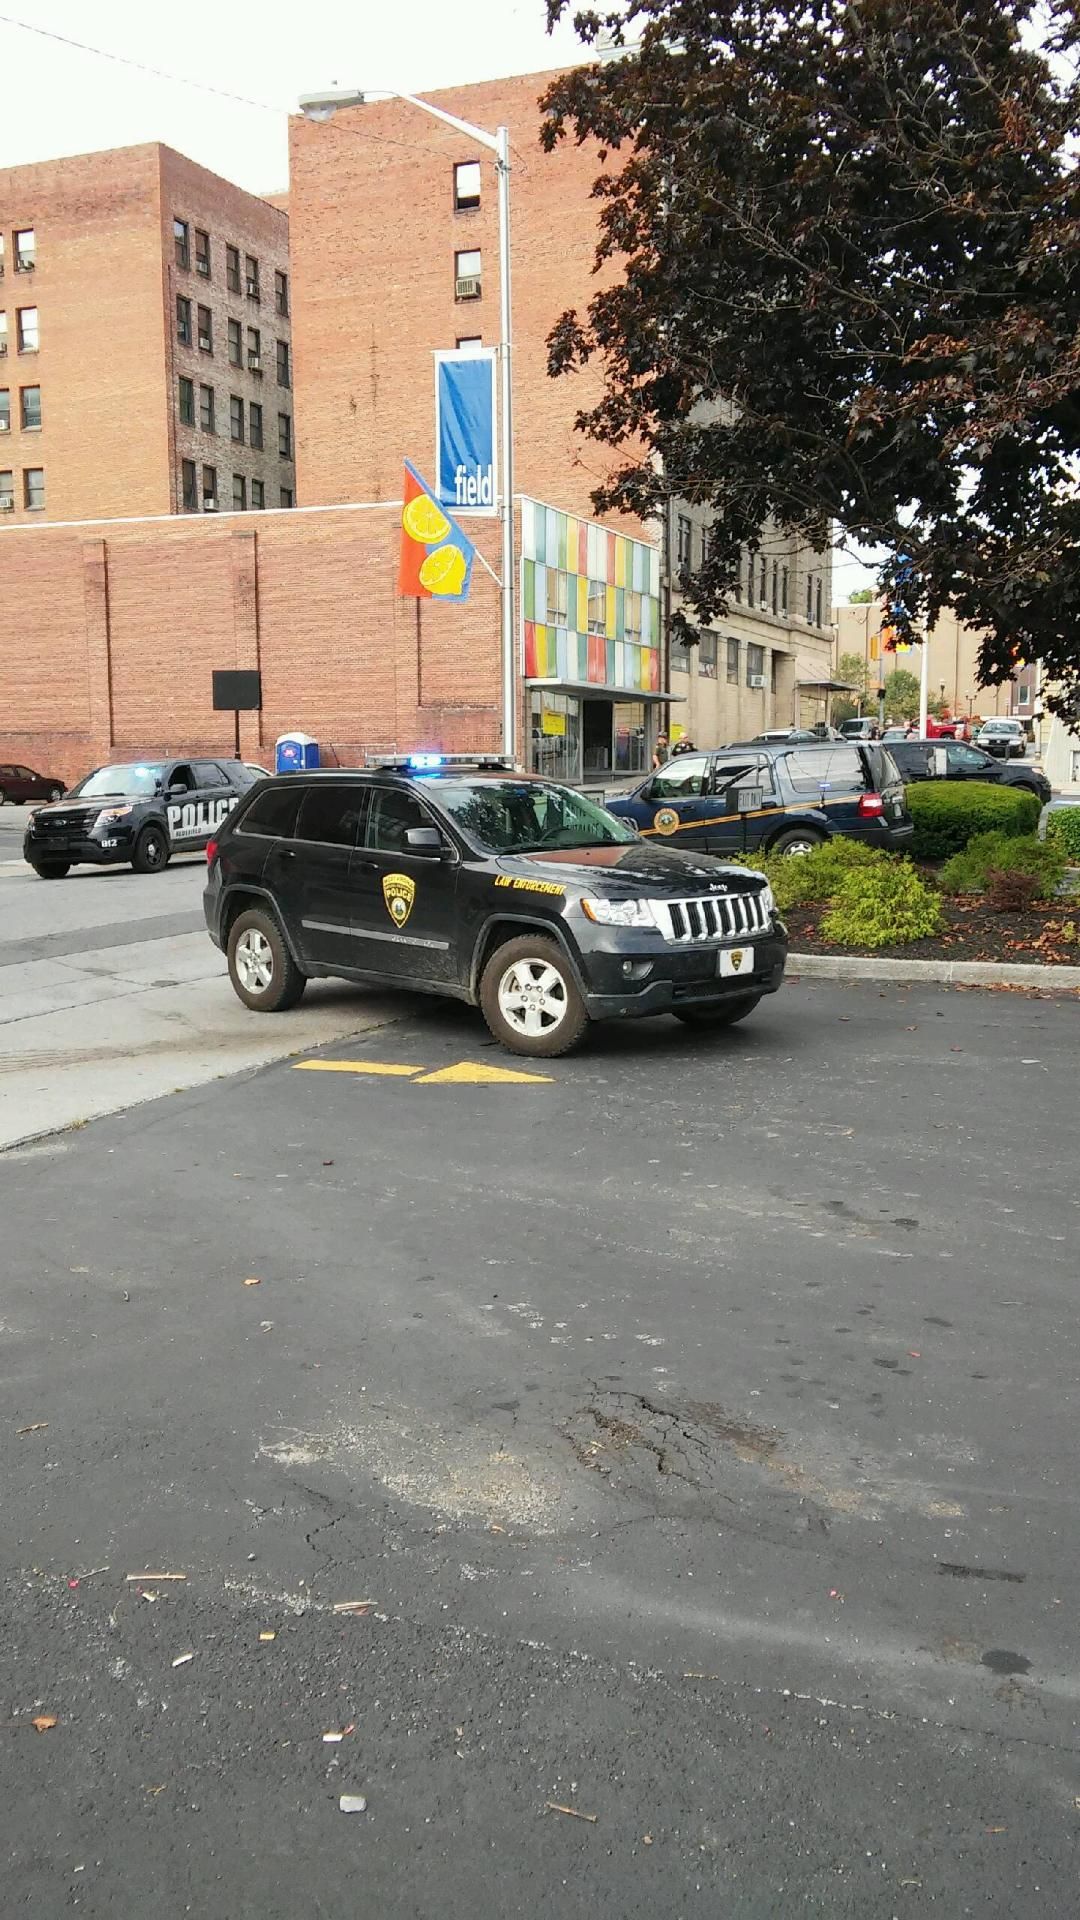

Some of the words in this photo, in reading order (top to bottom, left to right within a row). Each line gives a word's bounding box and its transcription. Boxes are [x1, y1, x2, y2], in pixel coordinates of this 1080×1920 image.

[454, 464, 492, 505] field
[495, 874, 512, 887] LAW
[513, 878, 567, 896] ENFORCEMENT
[709, 883, 728, 892] Jeep
[386, 887, 412, 902] POLICE
